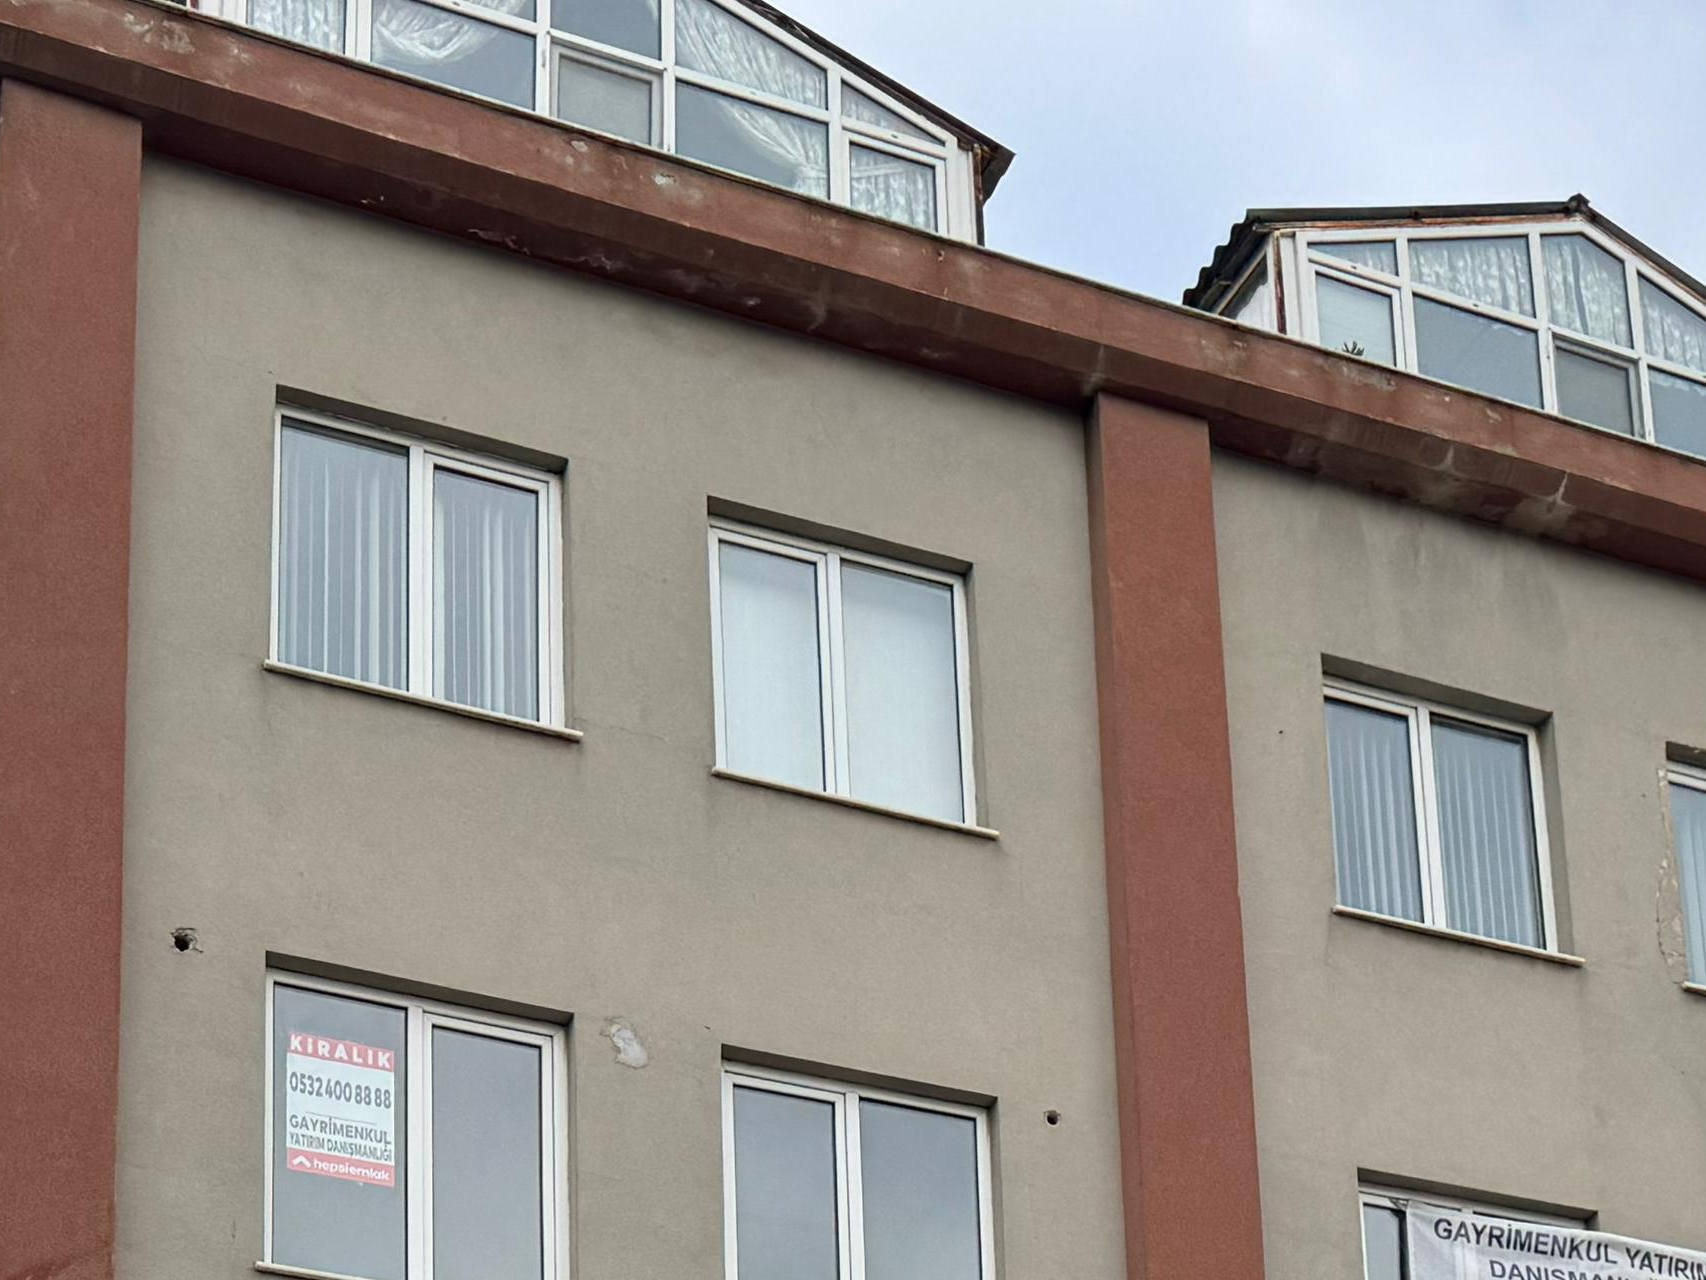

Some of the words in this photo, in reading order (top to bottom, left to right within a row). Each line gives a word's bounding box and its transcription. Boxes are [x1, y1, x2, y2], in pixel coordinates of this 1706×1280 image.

[289, 1071, 323, 1097] 0532
[325, 1078, 352, 1102] 400
[289, 1114, 392, 1146] GAYRİMENKUL
[1433, 1217, 1618, 1265] GAYRİMENKUL
